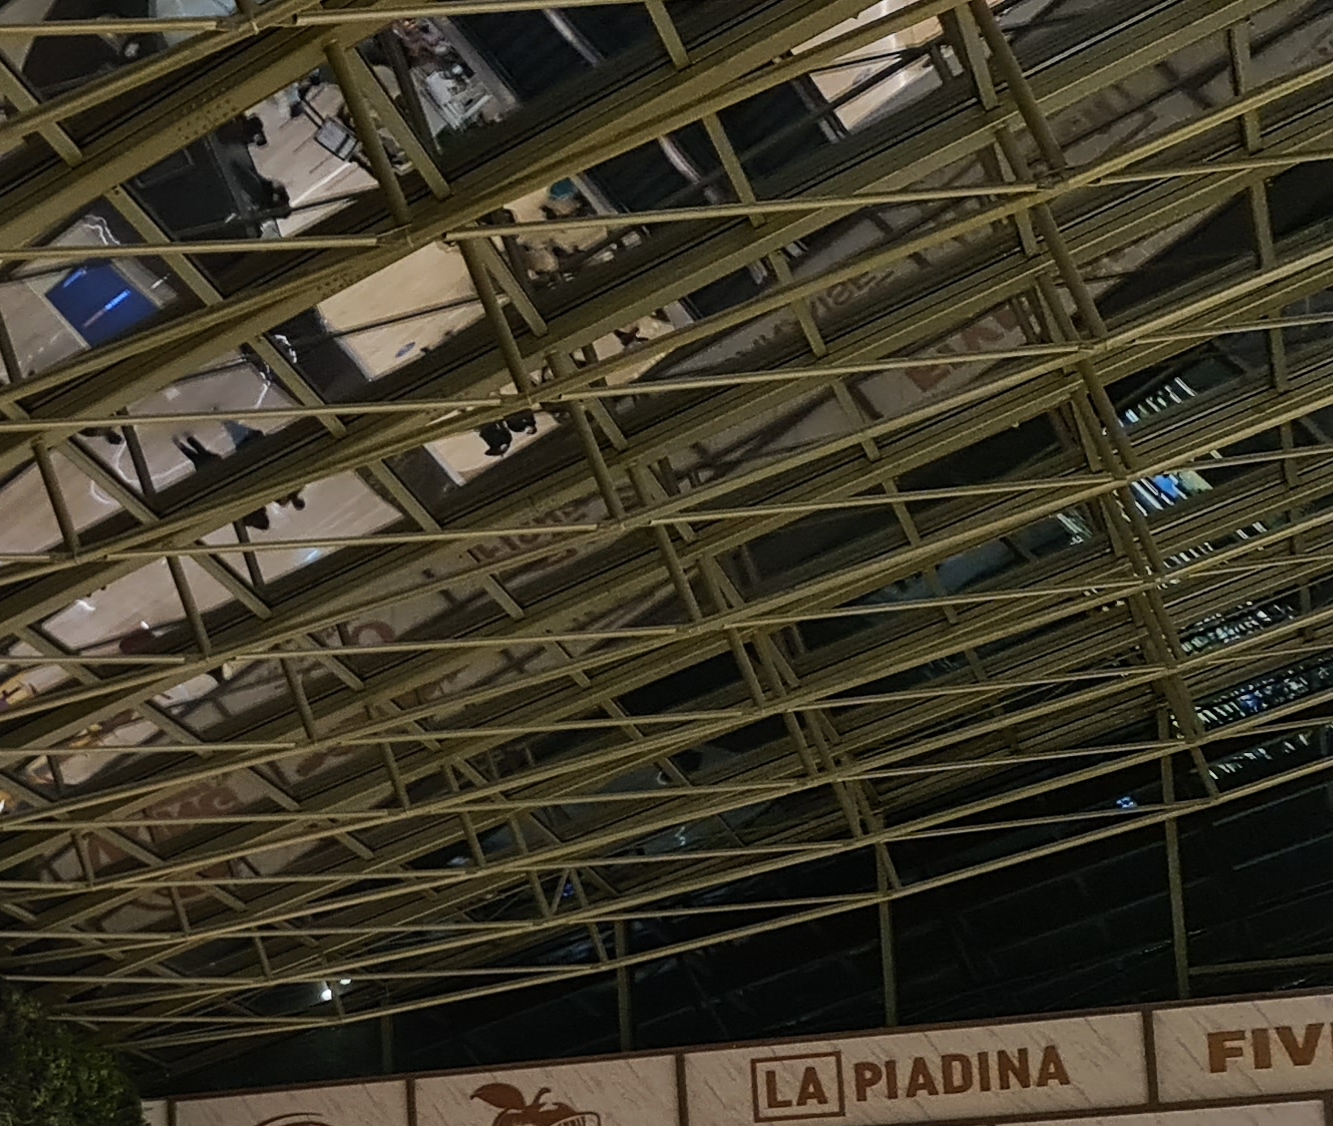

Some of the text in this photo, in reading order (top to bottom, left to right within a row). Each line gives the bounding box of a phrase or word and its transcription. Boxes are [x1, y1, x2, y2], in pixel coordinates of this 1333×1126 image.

[1207, 1021, 1333, 1074] FIV
[765, 1045, 1070, 1109] LA PIADINA
